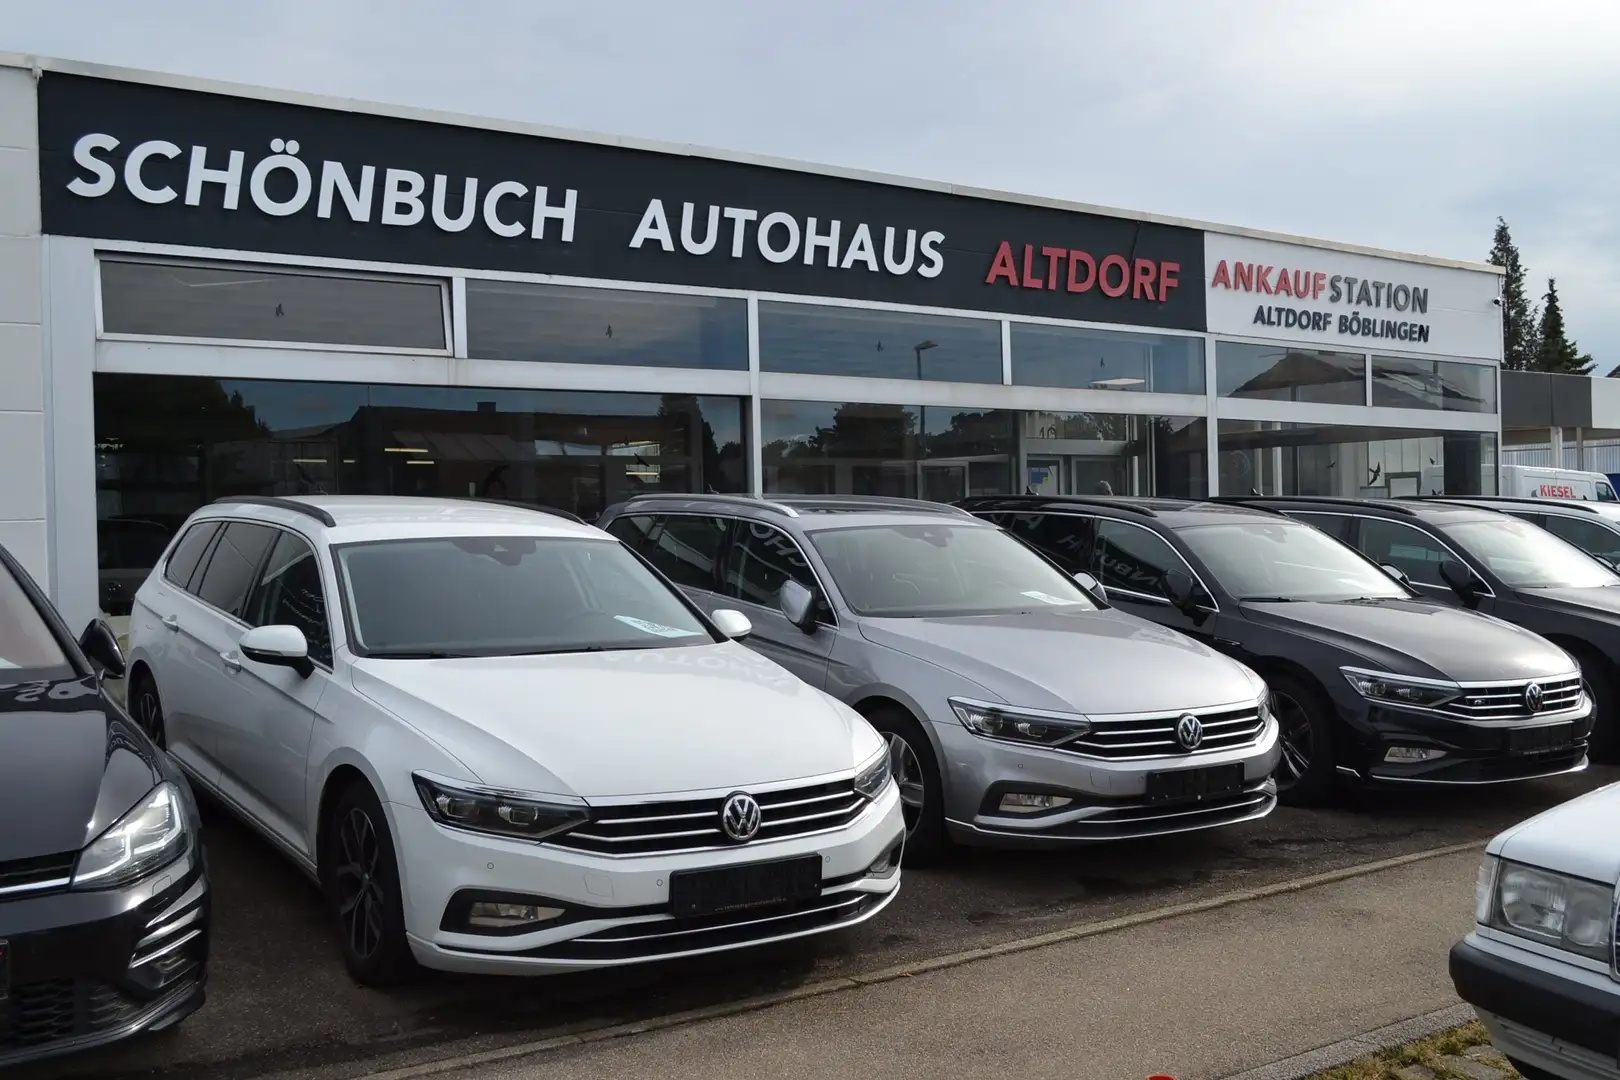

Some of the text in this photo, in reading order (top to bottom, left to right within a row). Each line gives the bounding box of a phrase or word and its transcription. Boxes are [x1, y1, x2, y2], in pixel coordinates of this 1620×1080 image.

[66, 133, 1181, 302] SCHÖNBUCH AUTOHAUS ALTDORF
[1253, 305, 1430, 343] ALTDORF BÖBLINGEN
[1540, 484, 1577, 499] KIESEL
